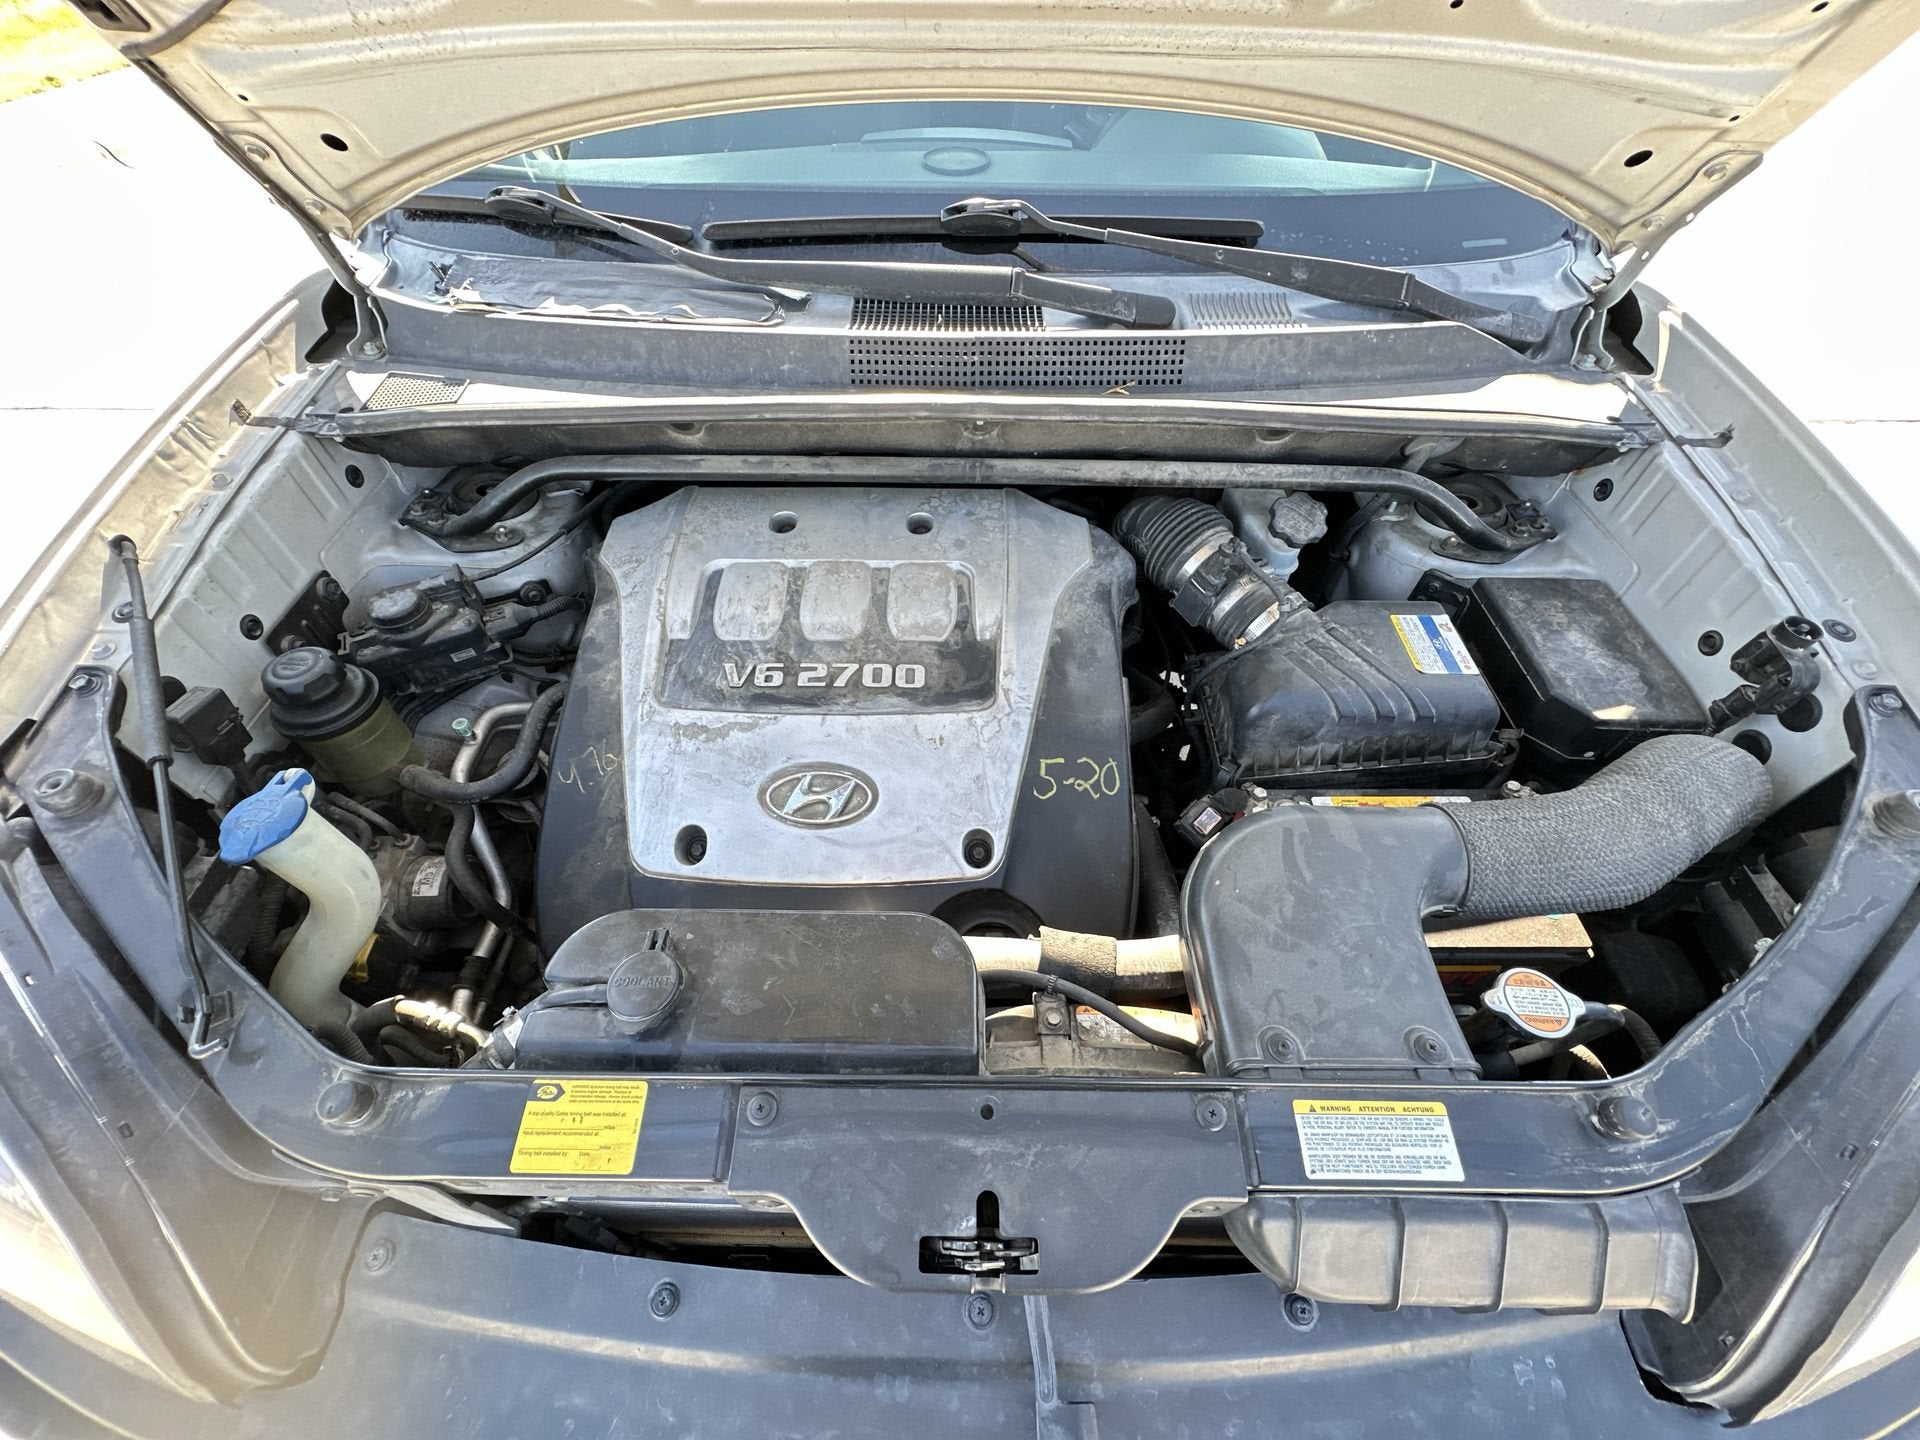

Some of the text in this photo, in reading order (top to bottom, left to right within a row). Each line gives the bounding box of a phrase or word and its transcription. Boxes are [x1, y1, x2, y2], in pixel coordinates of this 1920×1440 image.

[724, 662, 925, 688] V6 2700
[1033, 757, 1120, 799] 5-20
[614, 975, 672, 988] COOLANT
